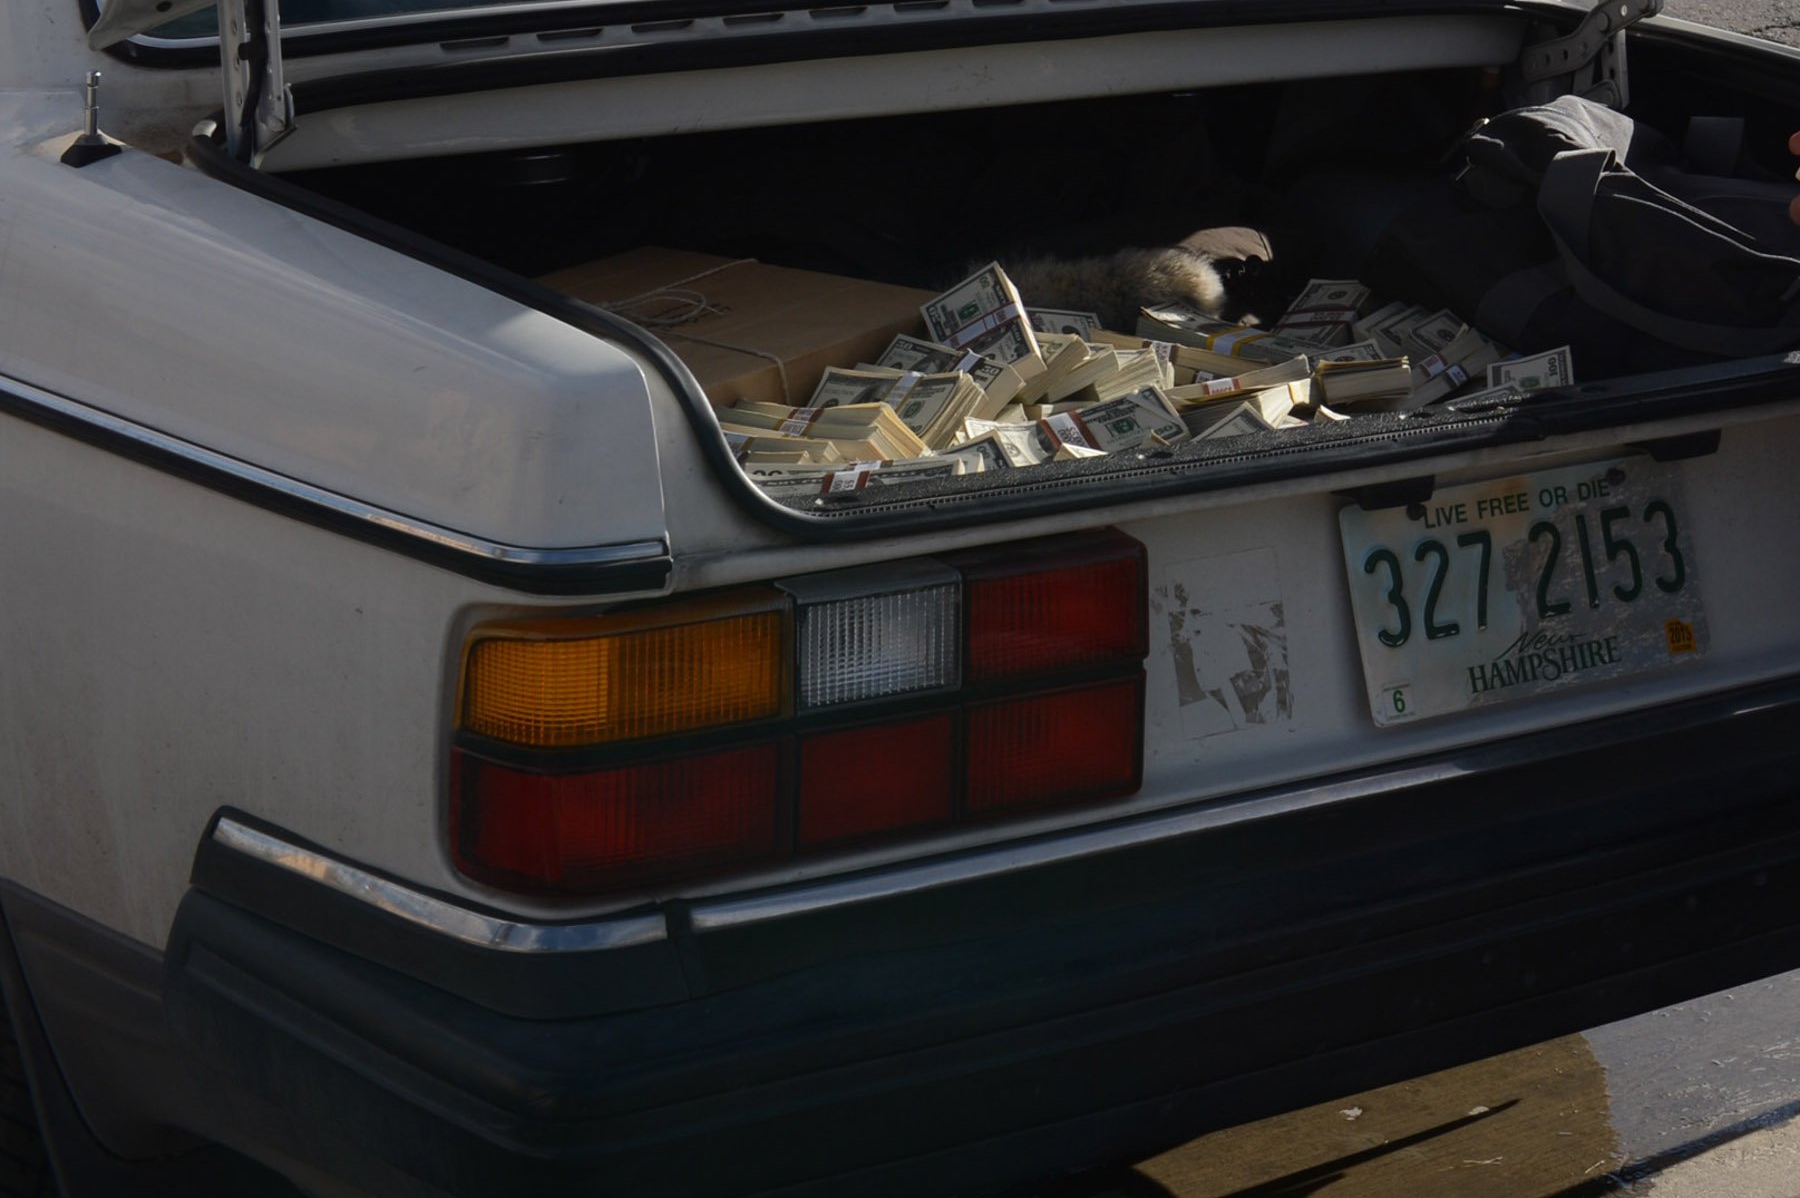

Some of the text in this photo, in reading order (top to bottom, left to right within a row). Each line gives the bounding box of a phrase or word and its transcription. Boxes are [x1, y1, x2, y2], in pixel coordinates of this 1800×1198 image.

[1424, 480, 1611, 528] LIVE FREE OR DIE
[1364, 499, 1685, 648] 327 2153
[1467, 636, 1622, 693] HAMPSHIRE
[1493, 629, 1586, 661] New
[1393, 689, 1405, 713] 6
